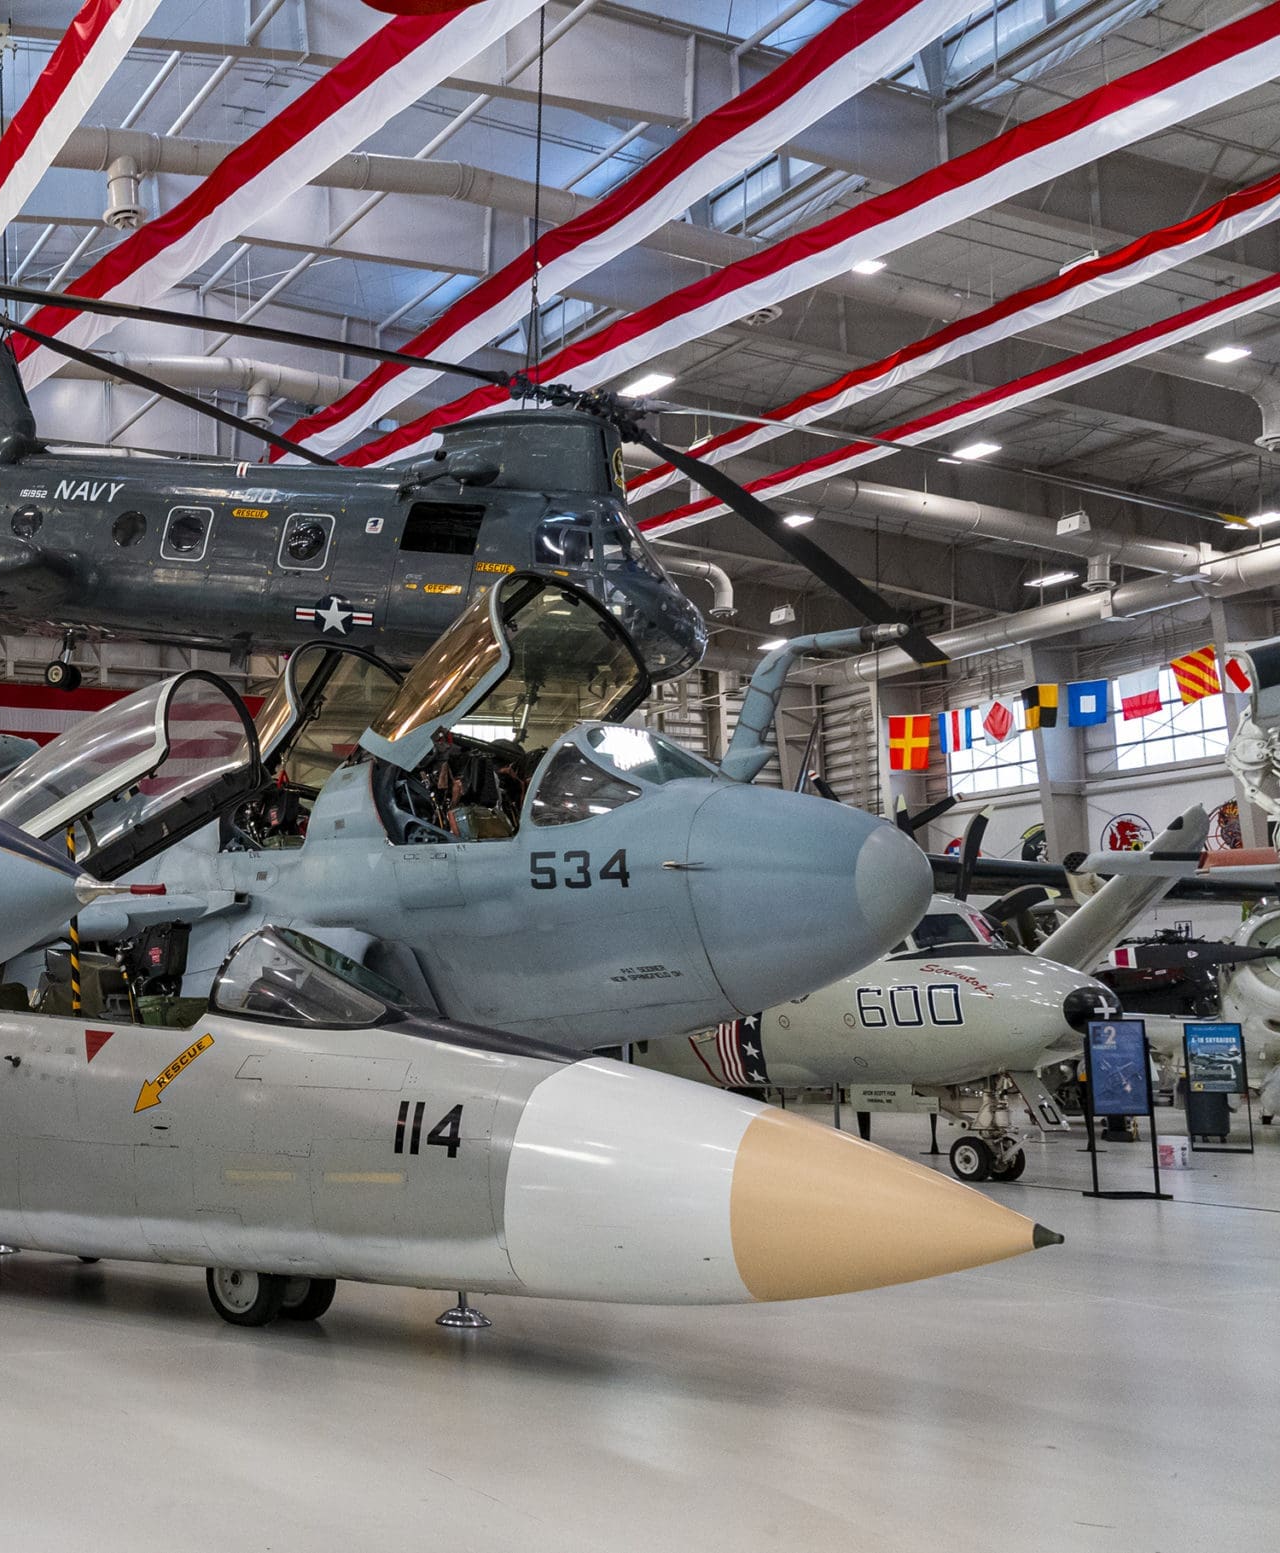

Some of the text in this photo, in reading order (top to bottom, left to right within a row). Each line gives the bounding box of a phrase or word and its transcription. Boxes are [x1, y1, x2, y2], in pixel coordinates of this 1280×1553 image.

[54, 479, 125, 503] NAVY
[236, 510, 265, 518] RESCUE
[477, 562, 512, 573] RESCUE
[530, 848, 630, 889] 534
[856, 983, 965, 1028] 600
[157, 1041, 206, 1088] RESCUE
[394, 1101, 463, 1158] 114
